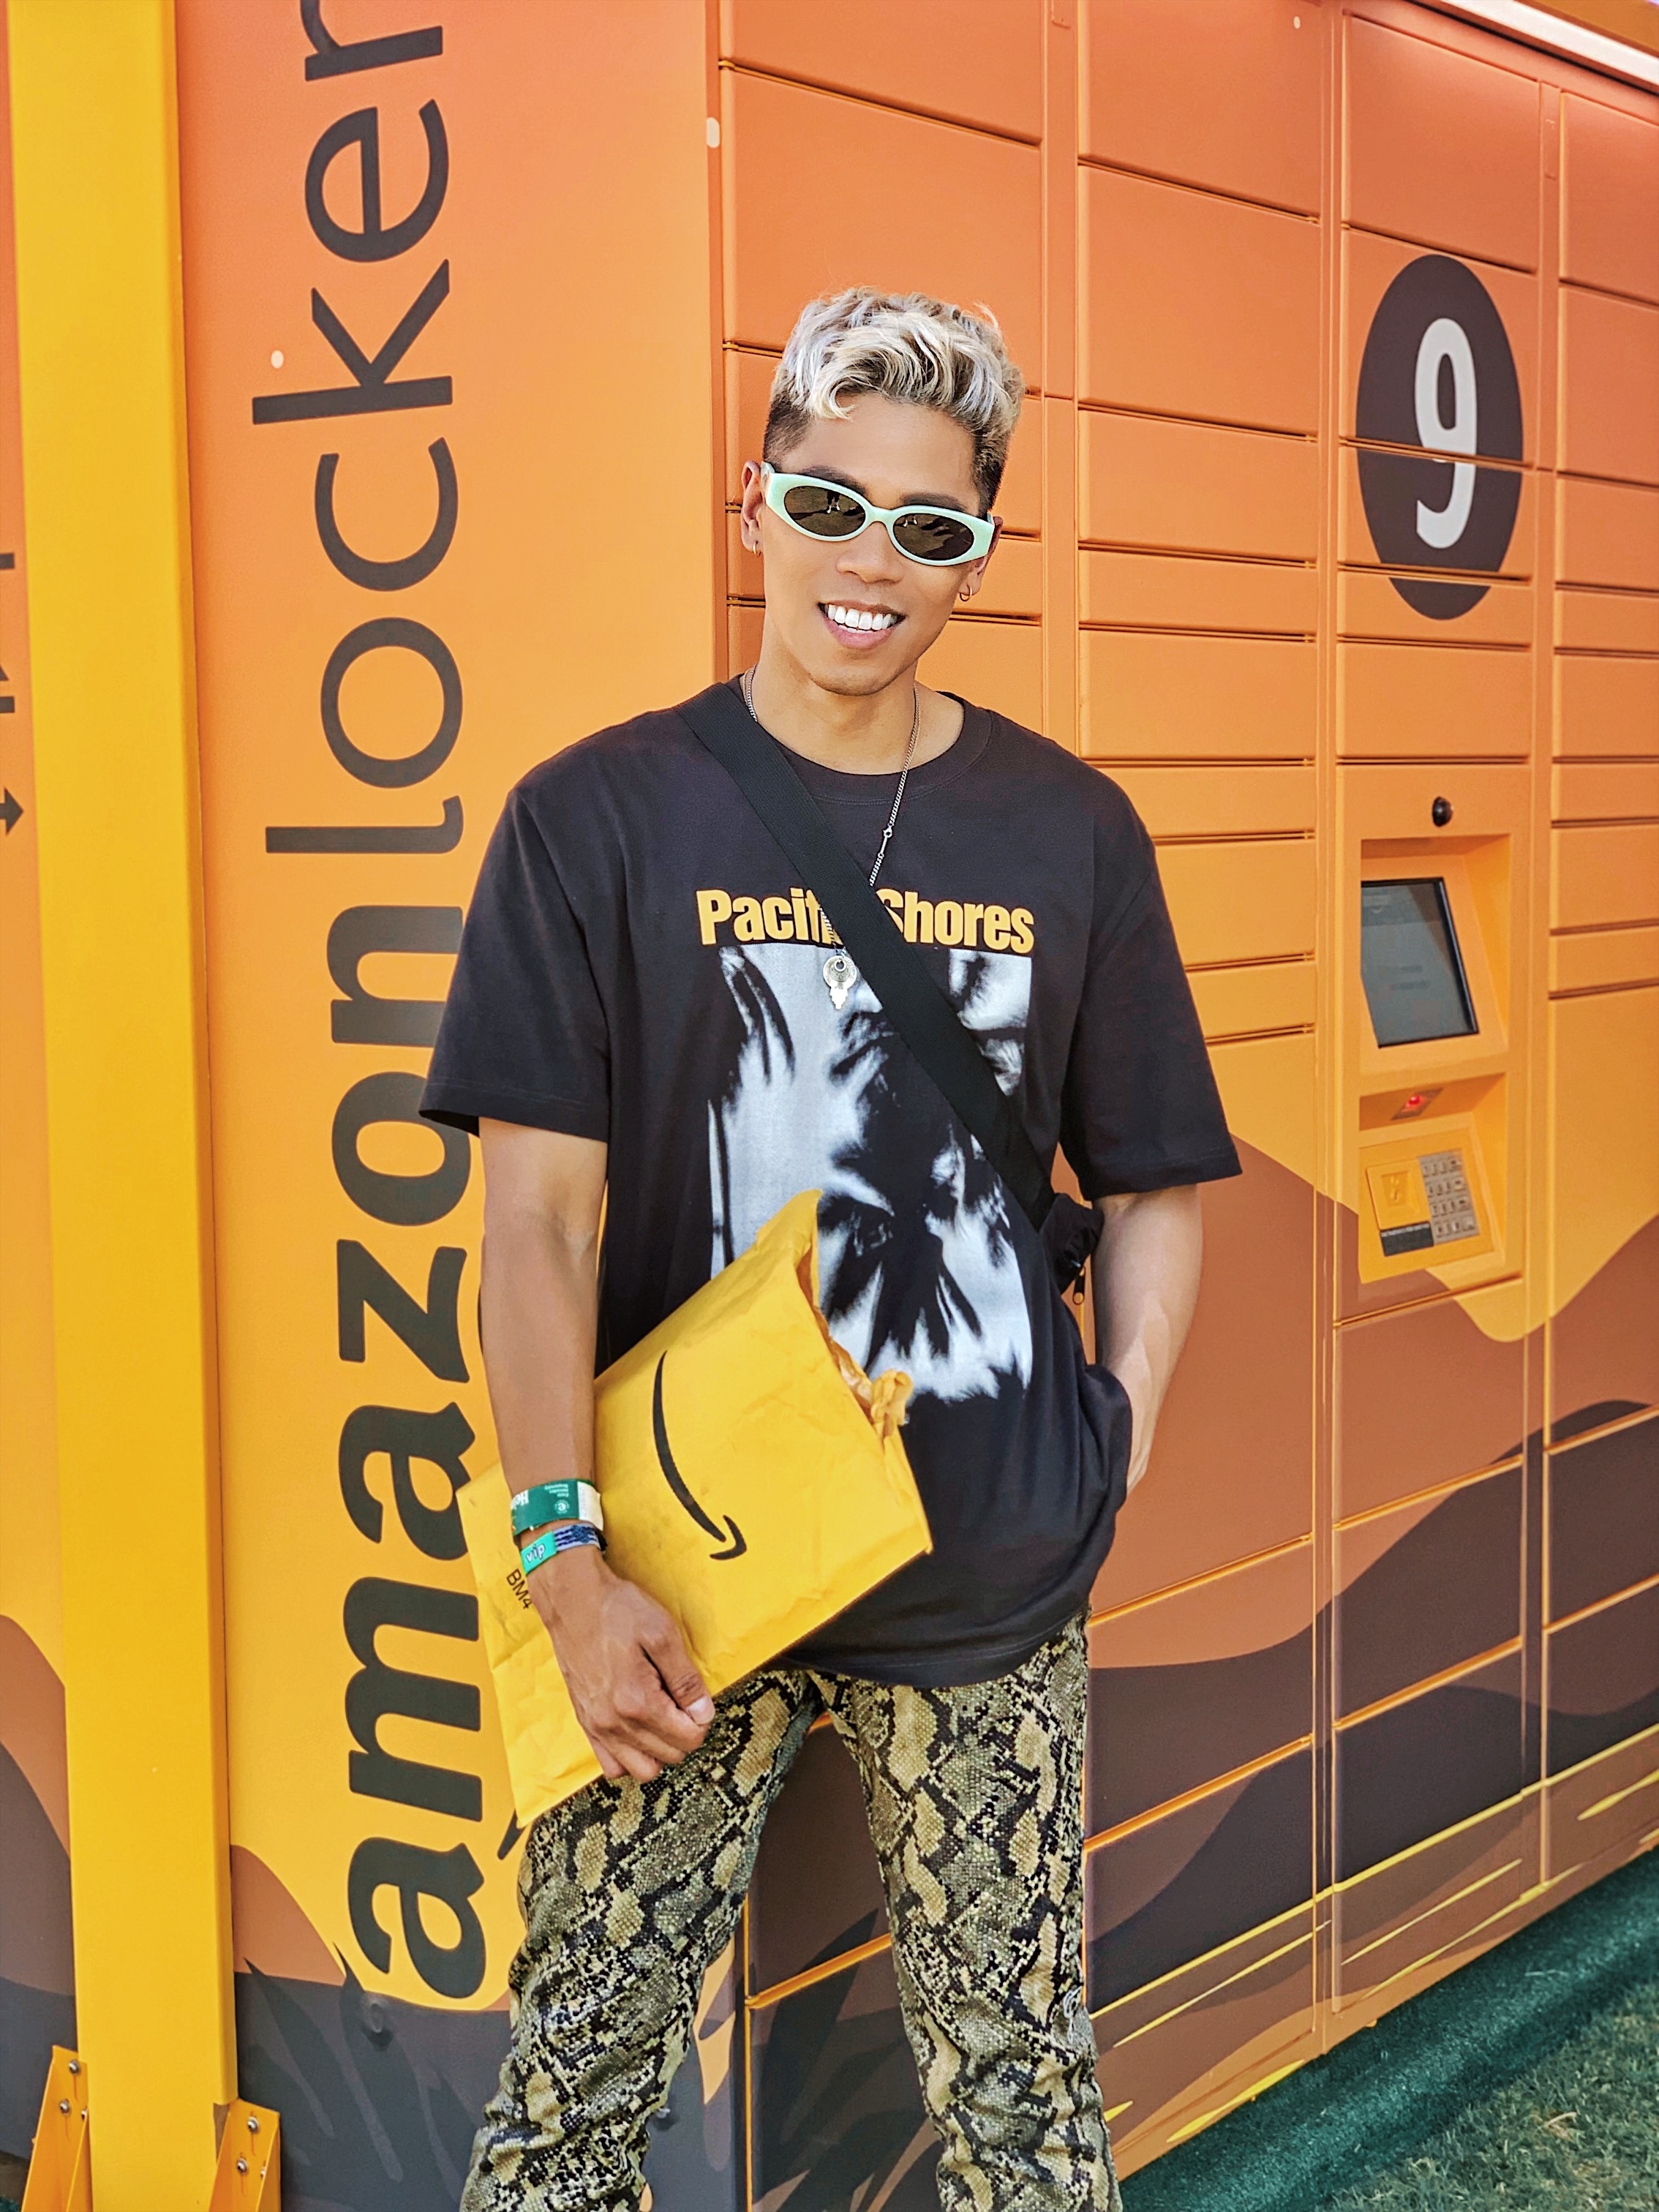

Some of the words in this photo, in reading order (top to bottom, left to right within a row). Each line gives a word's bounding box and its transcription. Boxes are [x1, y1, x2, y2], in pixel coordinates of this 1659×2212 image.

[1414, 317, 1478, 549] 9
[525, 1543, 546, 1563] vip
[506, 1568, 533, 1609] BM4
